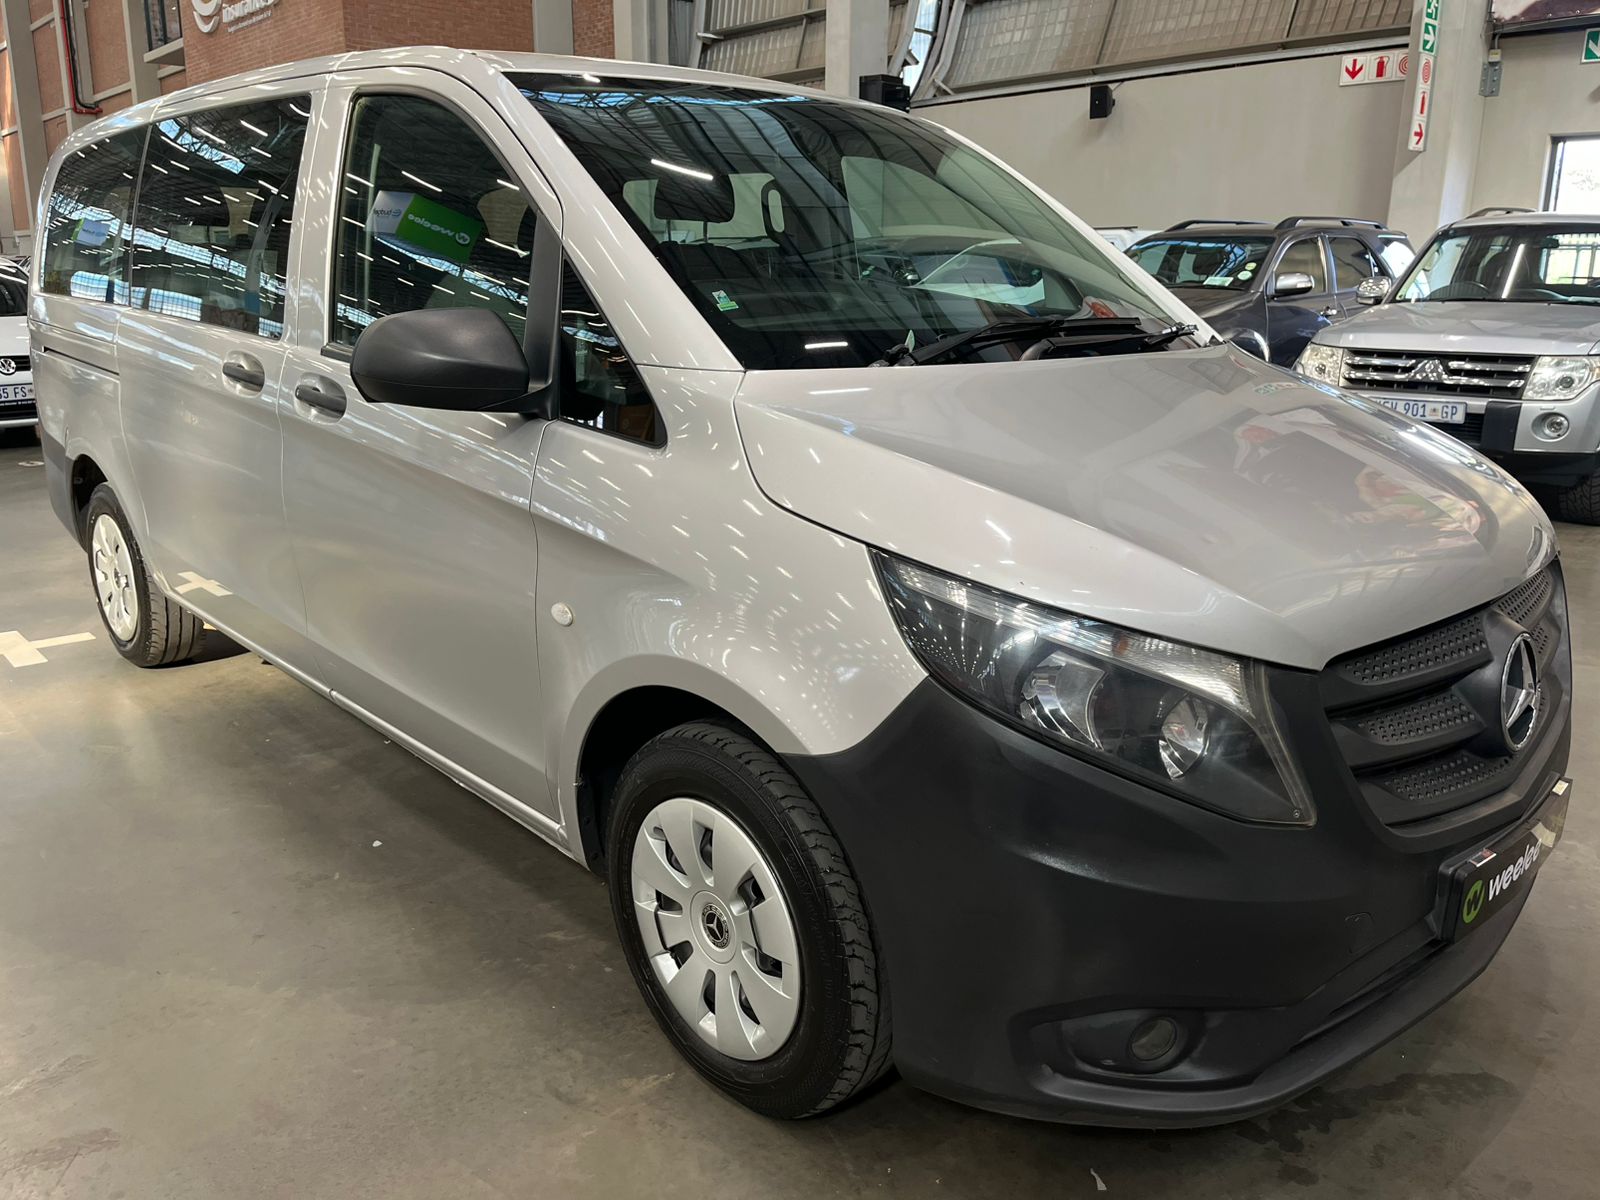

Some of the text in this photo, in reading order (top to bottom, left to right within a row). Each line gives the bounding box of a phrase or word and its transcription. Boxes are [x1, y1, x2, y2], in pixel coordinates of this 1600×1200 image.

[13, 386, 27, 398] FS
[1403, 403, 1427, 418] 901
[1441, 405, 1458, 420] GP
[1488, 838, 1543, 902] weelee
